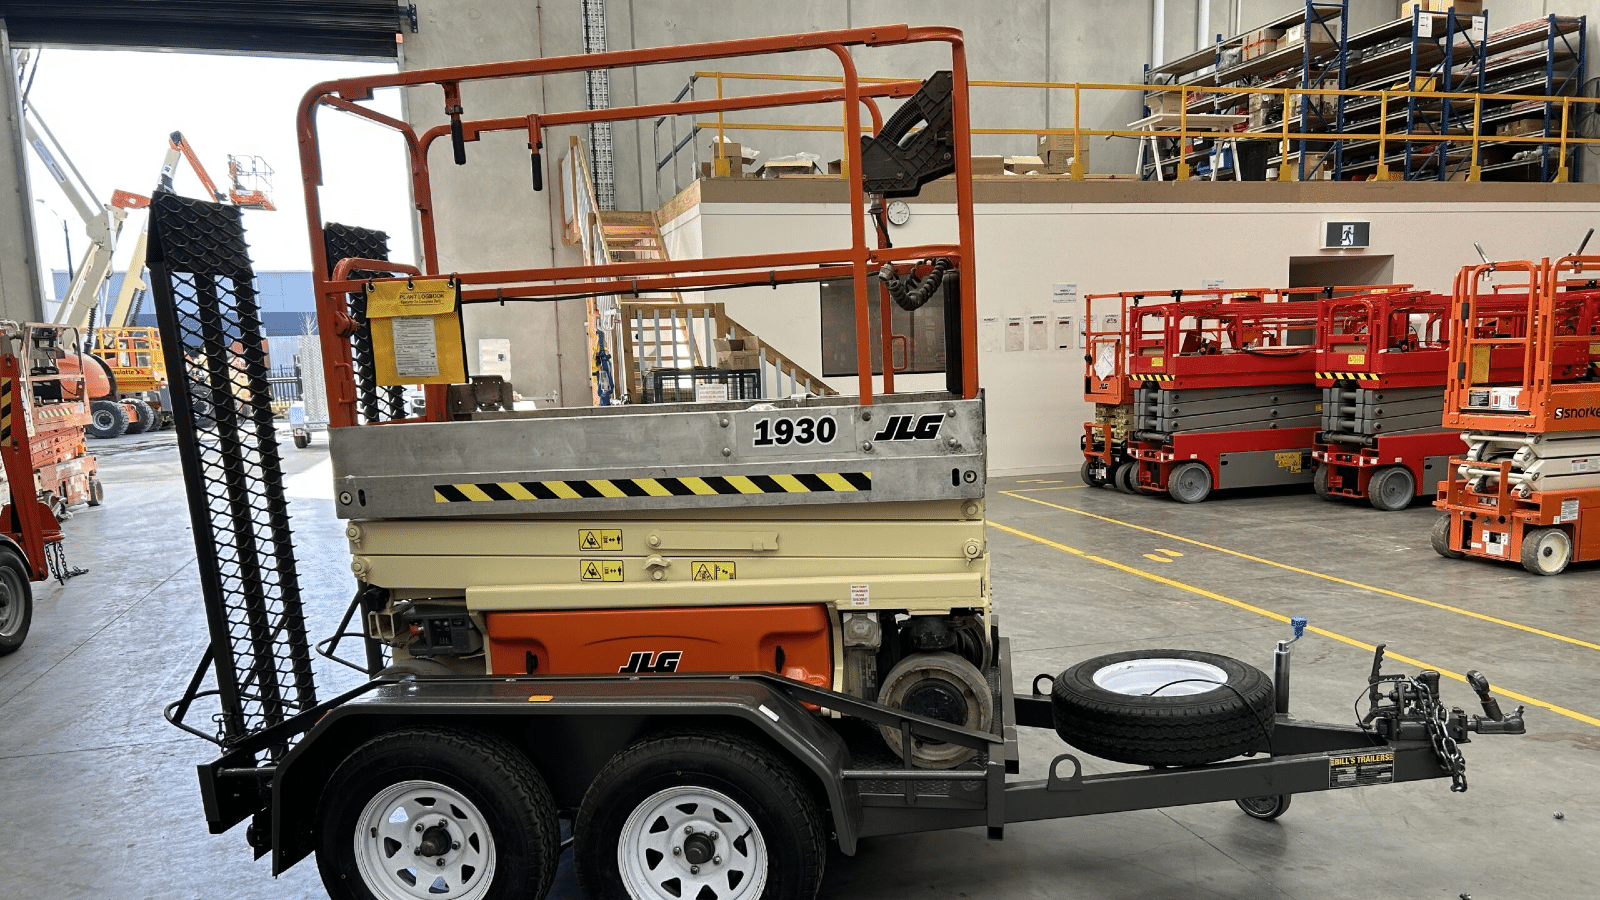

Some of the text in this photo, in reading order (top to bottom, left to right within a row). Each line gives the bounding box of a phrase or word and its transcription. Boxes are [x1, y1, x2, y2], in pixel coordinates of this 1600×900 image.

[1564, 406, 1600, 419] snorke
[753, 416, 838, 447] 1930
[873, 413, 946, 442] JLG
[617, 651, 683, 673] JLG
[1334, 753, 1390, 765] BILL'S TRAILERS
